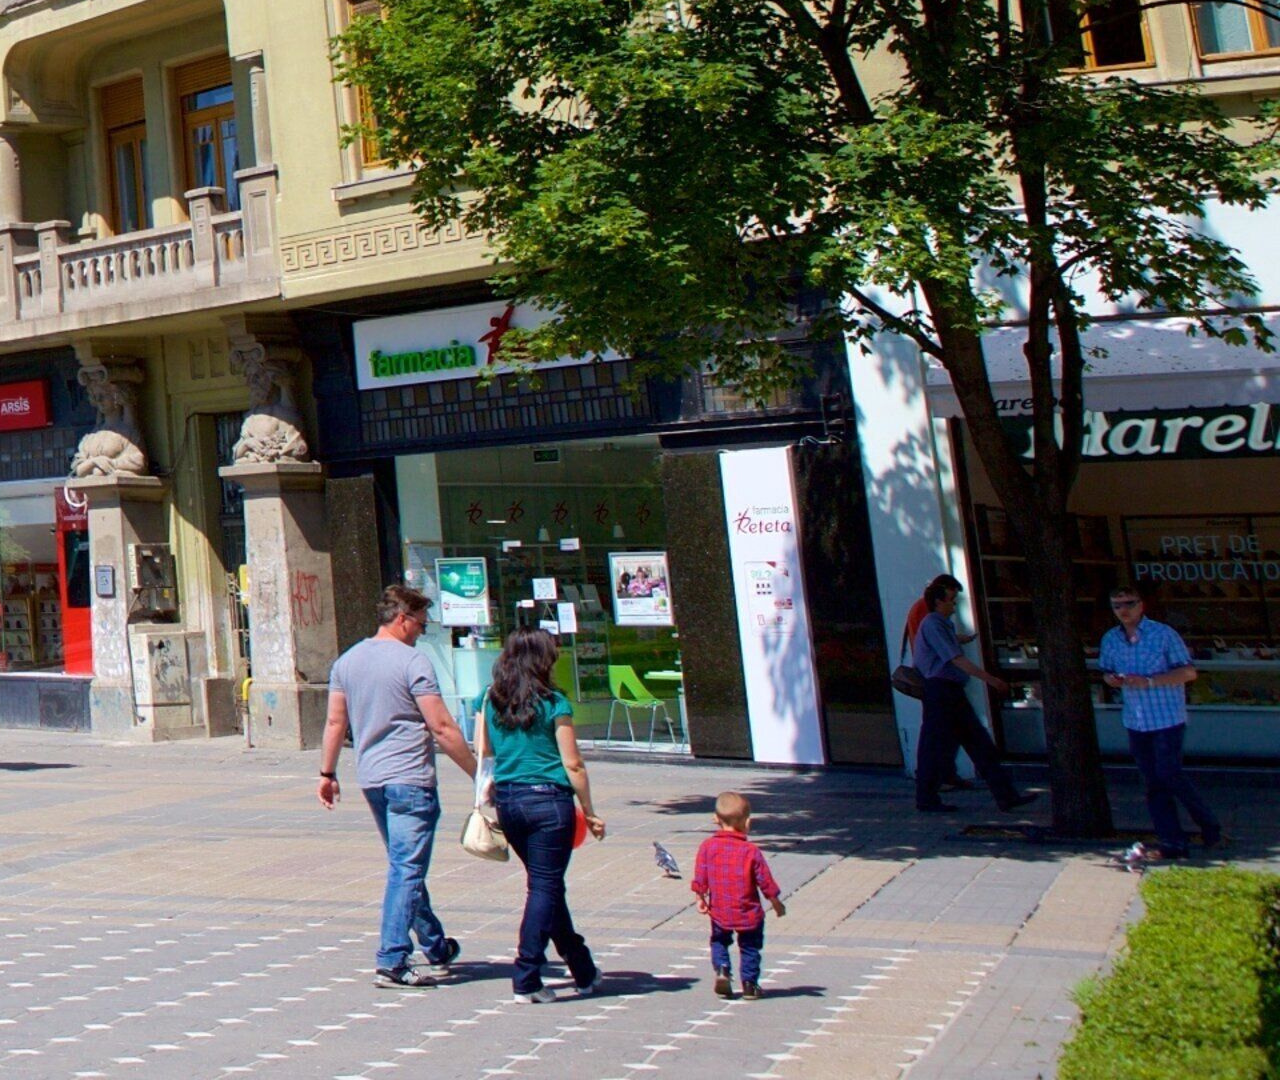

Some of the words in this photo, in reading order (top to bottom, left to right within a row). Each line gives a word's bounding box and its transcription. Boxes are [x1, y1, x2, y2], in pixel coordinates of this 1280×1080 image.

[369, 339, 476, 378] farmacia
[752, 505, 789, 514] farmacia
[1228, 534, 1260, 553] DE
